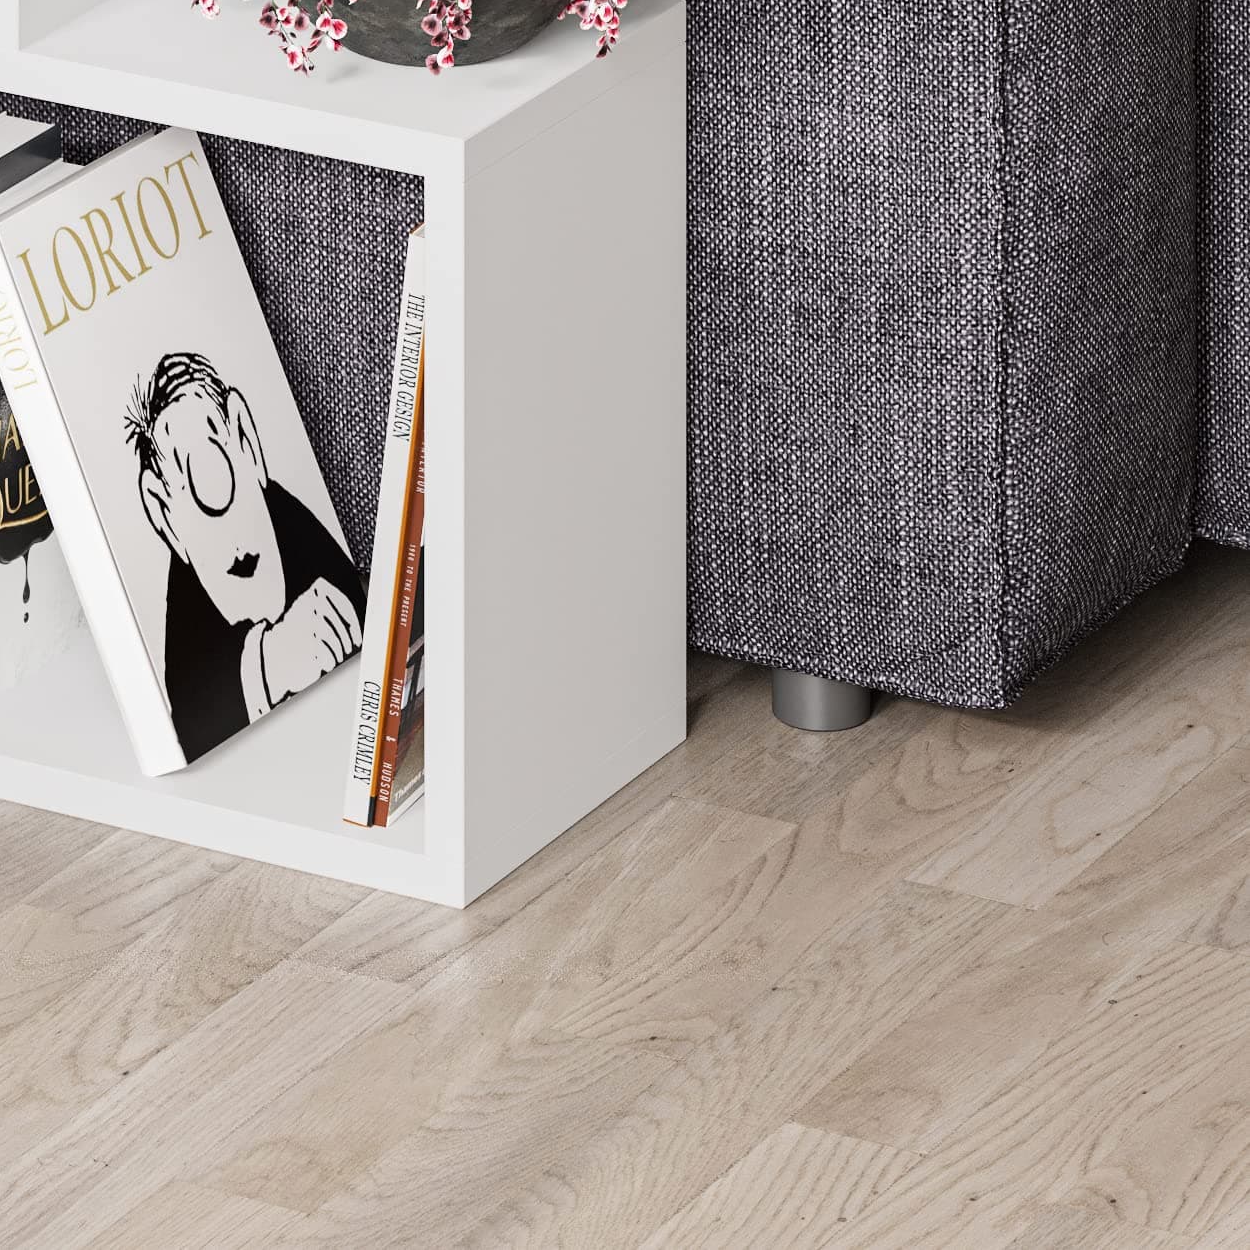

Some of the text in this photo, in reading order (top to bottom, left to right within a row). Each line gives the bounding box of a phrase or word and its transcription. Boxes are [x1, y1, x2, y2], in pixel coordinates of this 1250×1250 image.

[16, 150, 212, 335] LORIOT
[406, 294, 425, 321] THE
[399, 317, 422, 389] INTERIOR
[360, 681, 381, 723] CHRIS
[389, 678, 403, 718] THAMES
[379, 761, 393, 803] HUDSON
